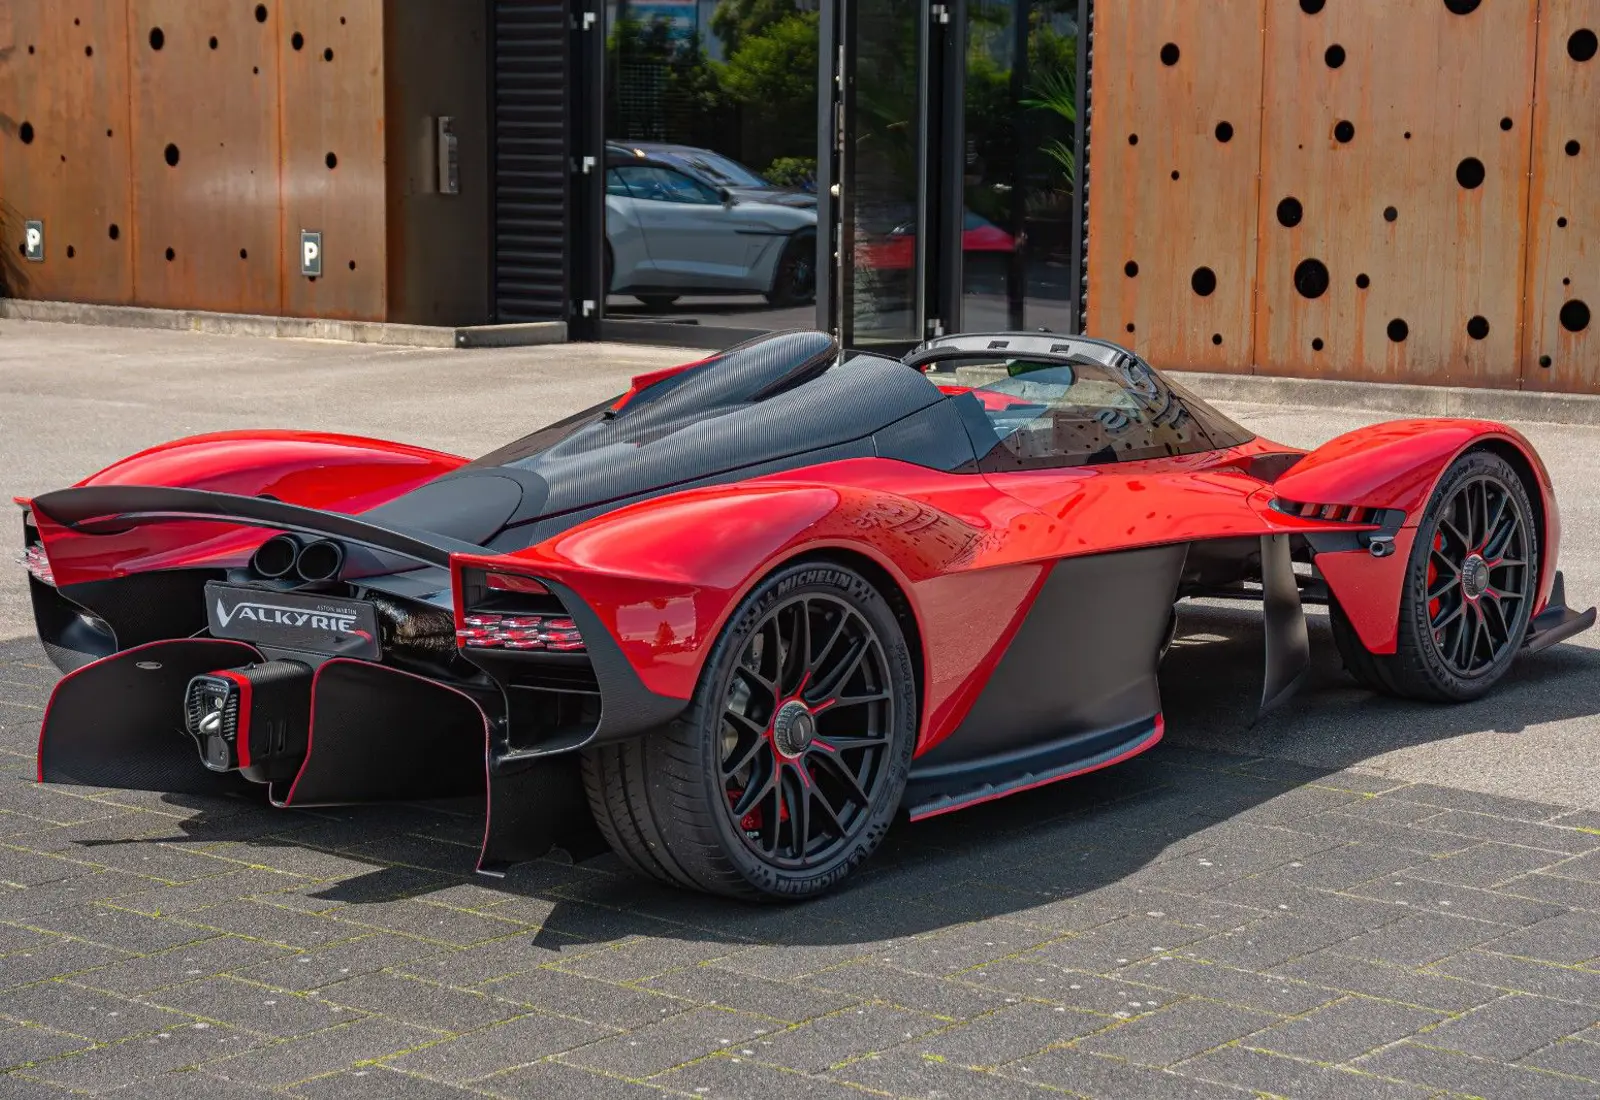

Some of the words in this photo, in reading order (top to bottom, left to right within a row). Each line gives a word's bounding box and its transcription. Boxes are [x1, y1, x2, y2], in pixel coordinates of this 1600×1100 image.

[27, 228, 40, 252] P
[304, 242, 318, 266] P
[777, 570, 852, 592] MICHELIN
[216, 598, 357, 634] VALKYRIE
